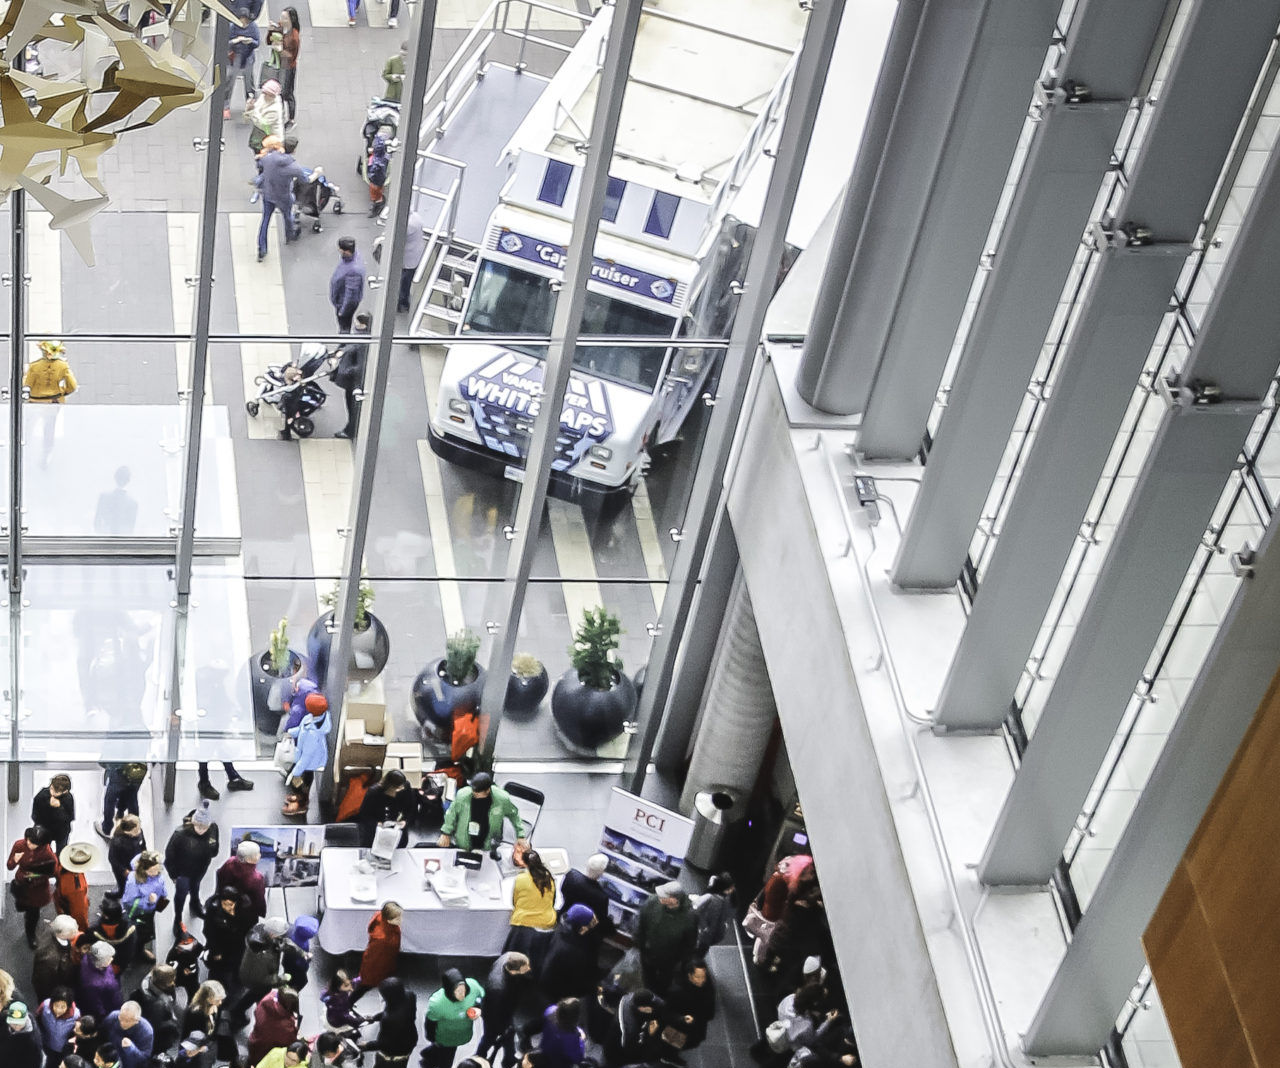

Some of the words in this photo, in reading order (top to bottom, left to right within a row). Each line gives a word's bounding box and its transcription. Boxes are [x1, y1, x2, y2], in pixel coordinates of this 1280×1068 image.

[535, 244, 568, 268] 'Cap
[591, 266, 640, 288] ruiser
[467, 376, 609, 437] WHITEAPS
[634, 808, 666, 832] PCI
